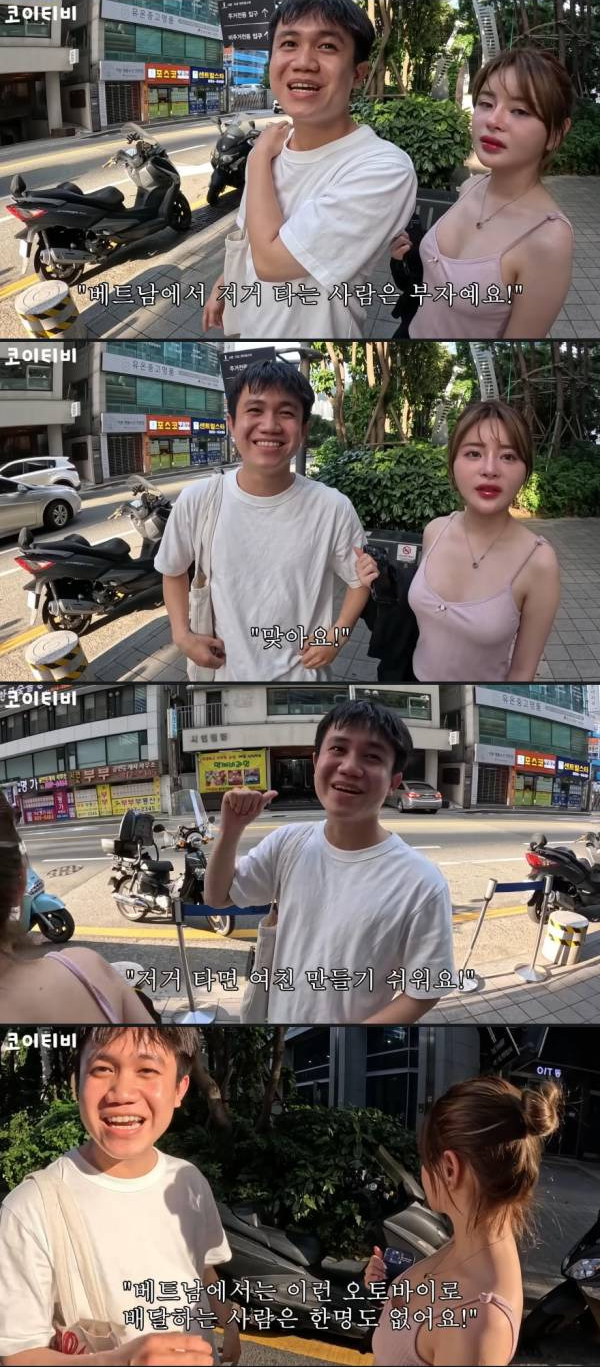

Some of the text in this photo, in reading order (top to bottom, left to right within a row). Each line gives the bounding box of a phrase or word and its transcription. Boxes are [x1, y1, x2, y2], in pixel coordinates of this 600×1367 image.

[156, 69, 177, 78] 포스코
[157, 421, 177, 430] 포스코
[525, 757, 544, 765] 포스코
